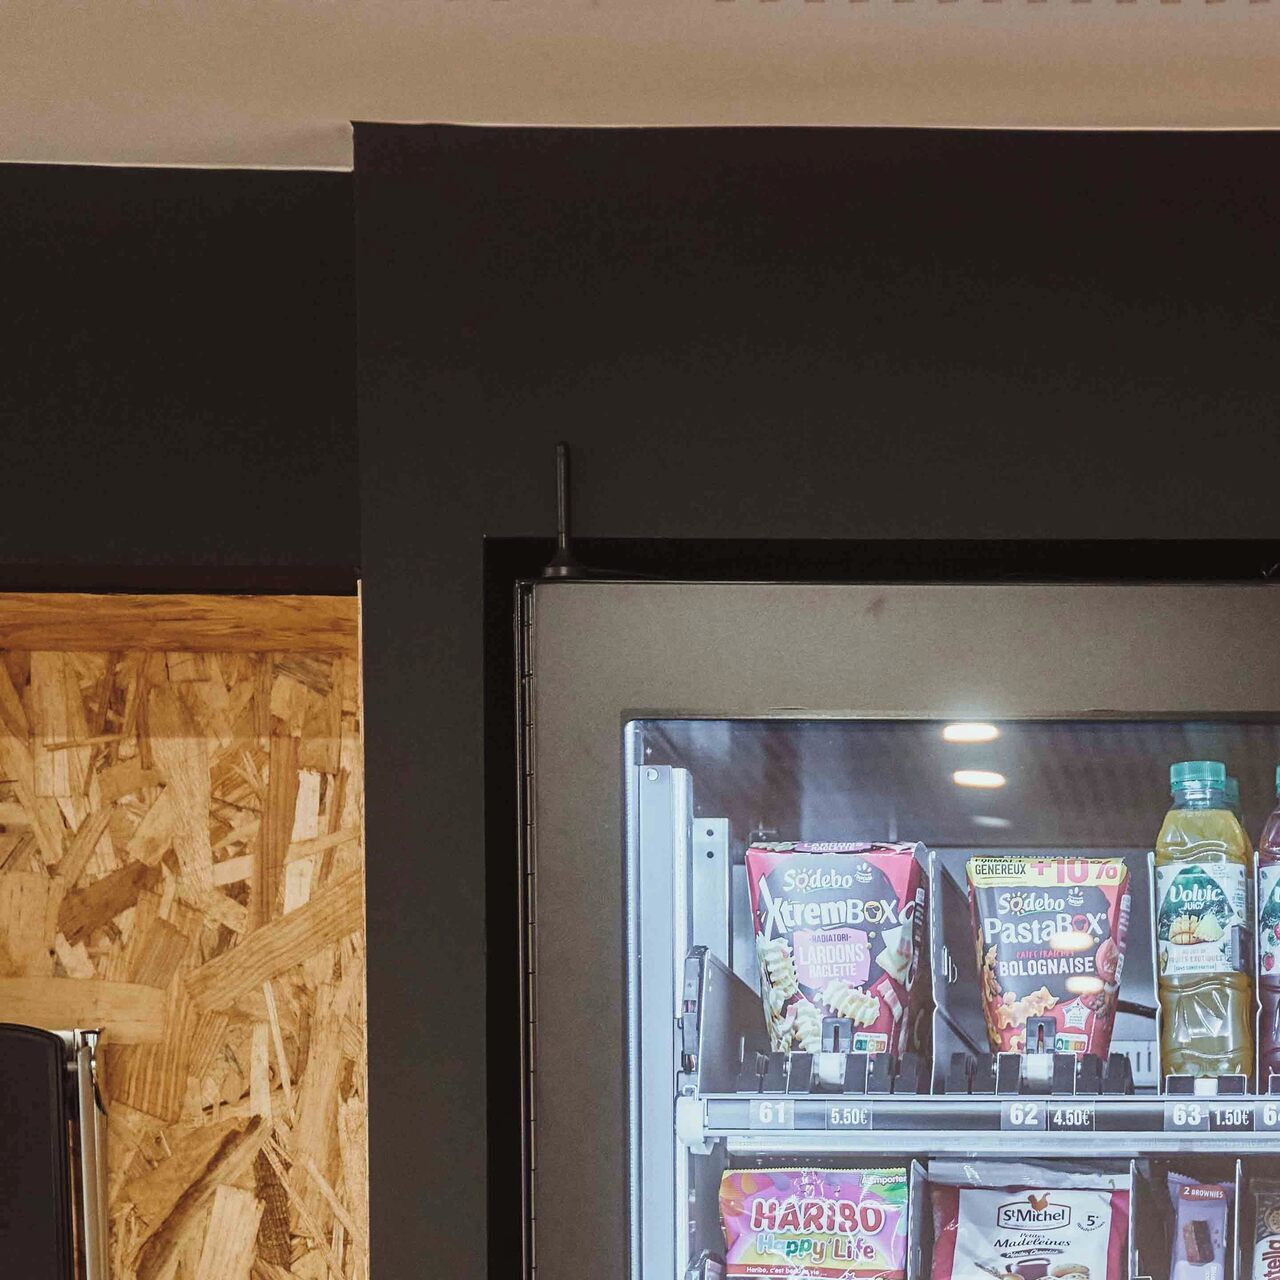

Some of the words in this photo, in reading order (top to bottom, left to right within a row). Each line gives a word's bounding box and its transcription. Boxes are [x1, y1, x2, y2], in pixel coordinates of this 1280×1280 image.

[1169, 883, 1225, 902] Volvic
[799, 943, 865, 965] LARDONS
[1000, 957, 1095, 977] BOLOGNAISE
[759, 1102, 786, 1124] 61
[830, 1107, 868, 1126] 5.50€
[1009, 1104, 1038, 1126] 62
[1053, 1107, 1090, 1126] 4.50€
[1172, 1104, 1201, 1126] 63
[1214, 1108, 1249, 1127] 1.50€
[1183, 1186, 1190, 1195] 2
[1191, 1187, 1224, 1199] BROWNIES
[753, 1200, 883, 1232] HARIBO
